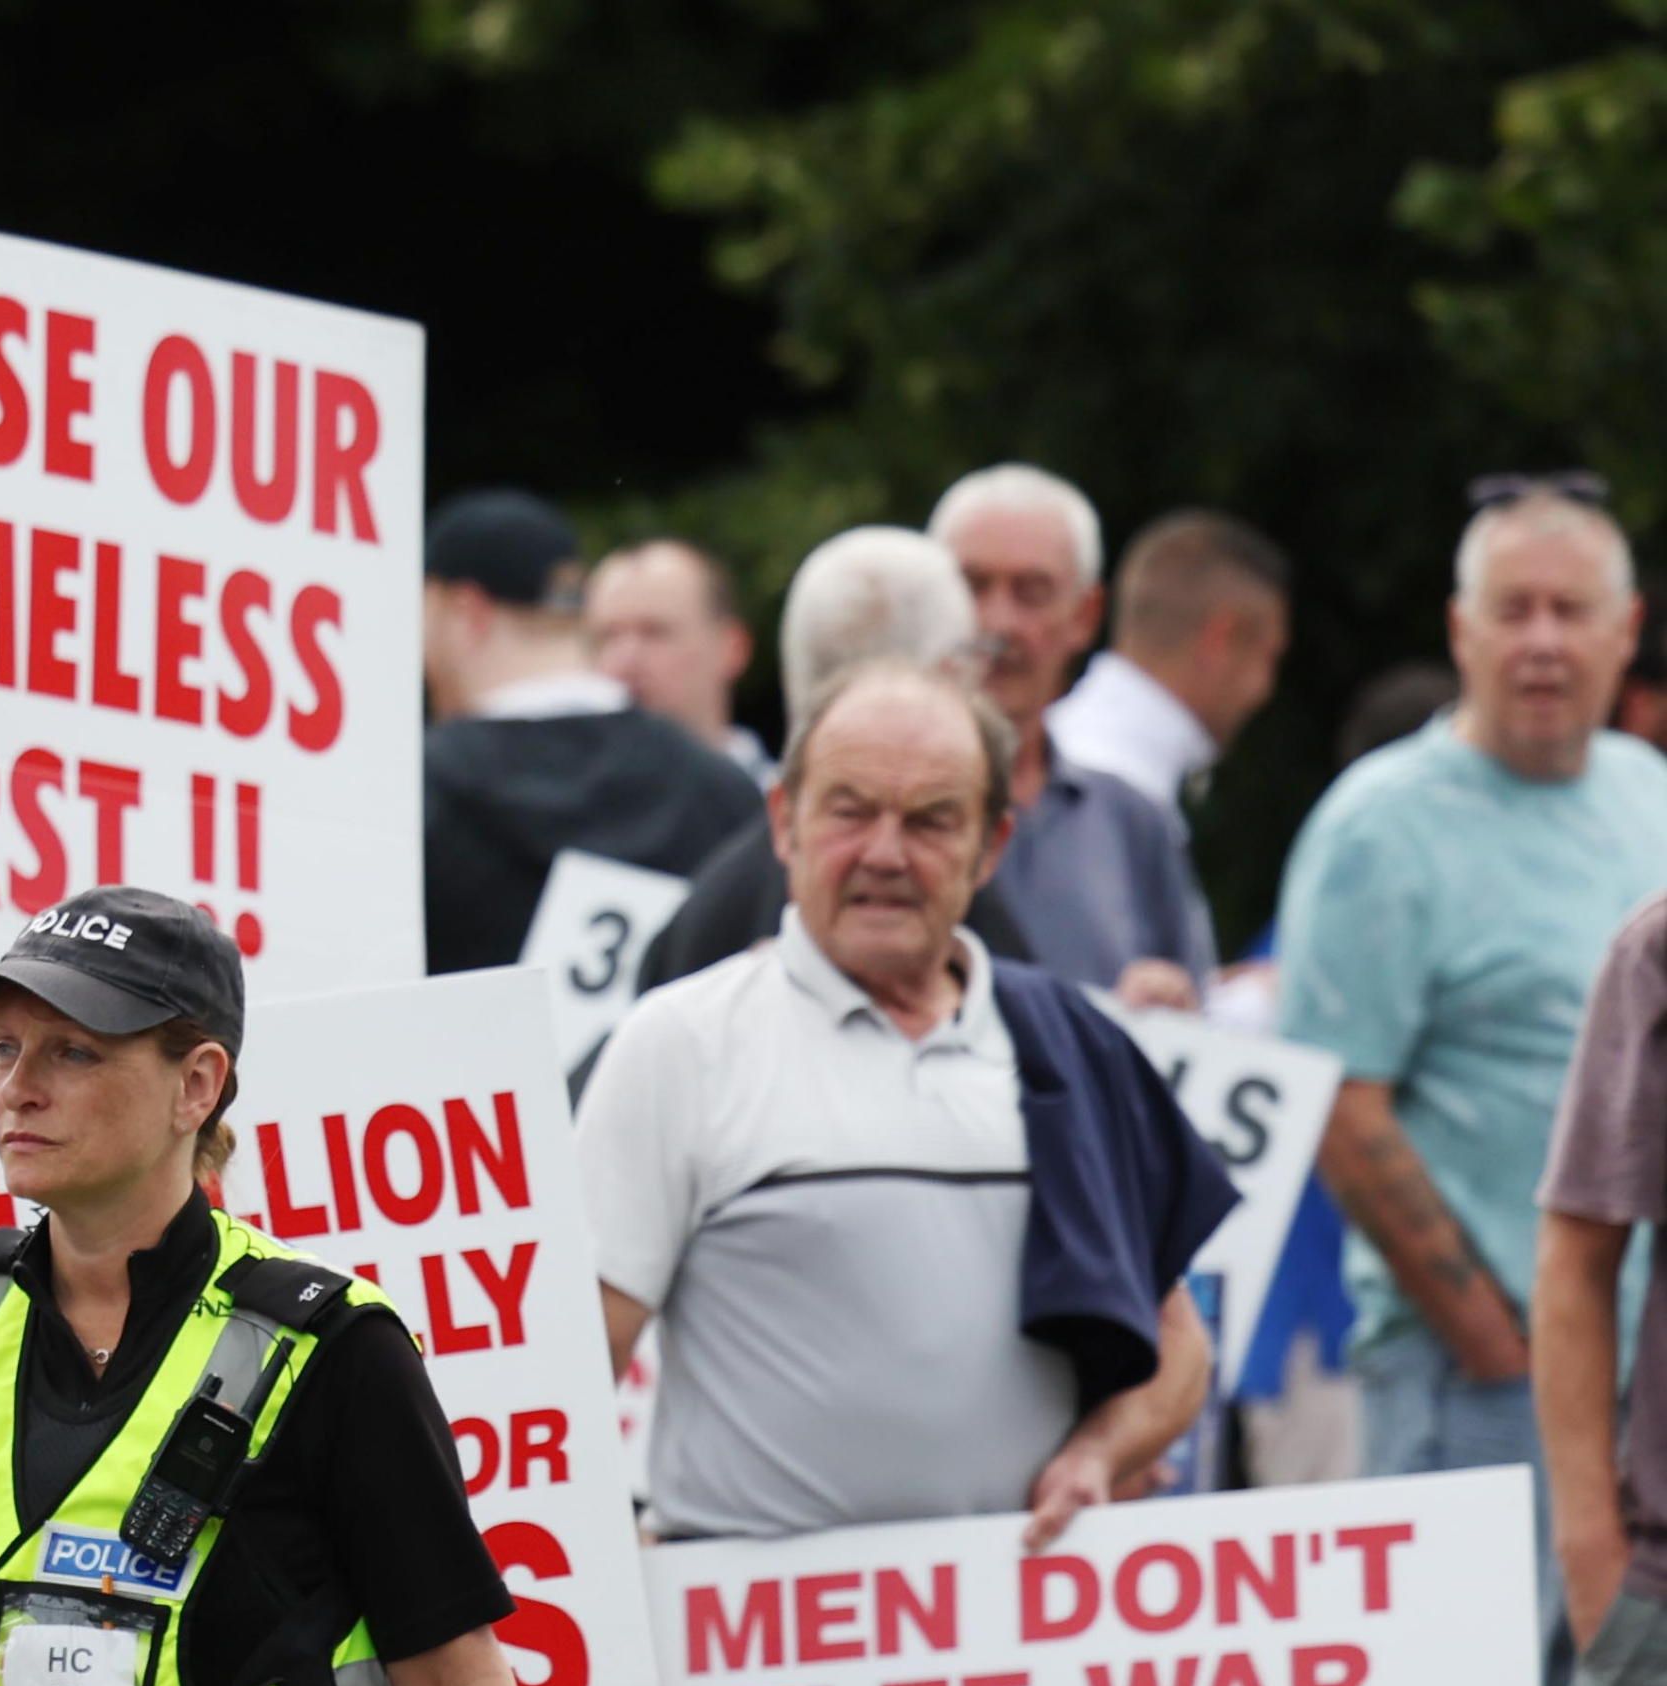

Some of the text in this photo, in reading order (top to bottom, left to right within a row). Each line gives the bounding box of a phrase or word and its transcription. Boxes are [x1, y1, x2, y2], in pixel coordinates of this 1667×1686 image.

[141, 333, 381, 546] OUR
[51, 1539, 177, 1585] POLICE
[683, 1562, 960, 1677] MEN
[1018, 1521, 1415, 1646] DON'T
[48, 1647, 93, 1674] HC
